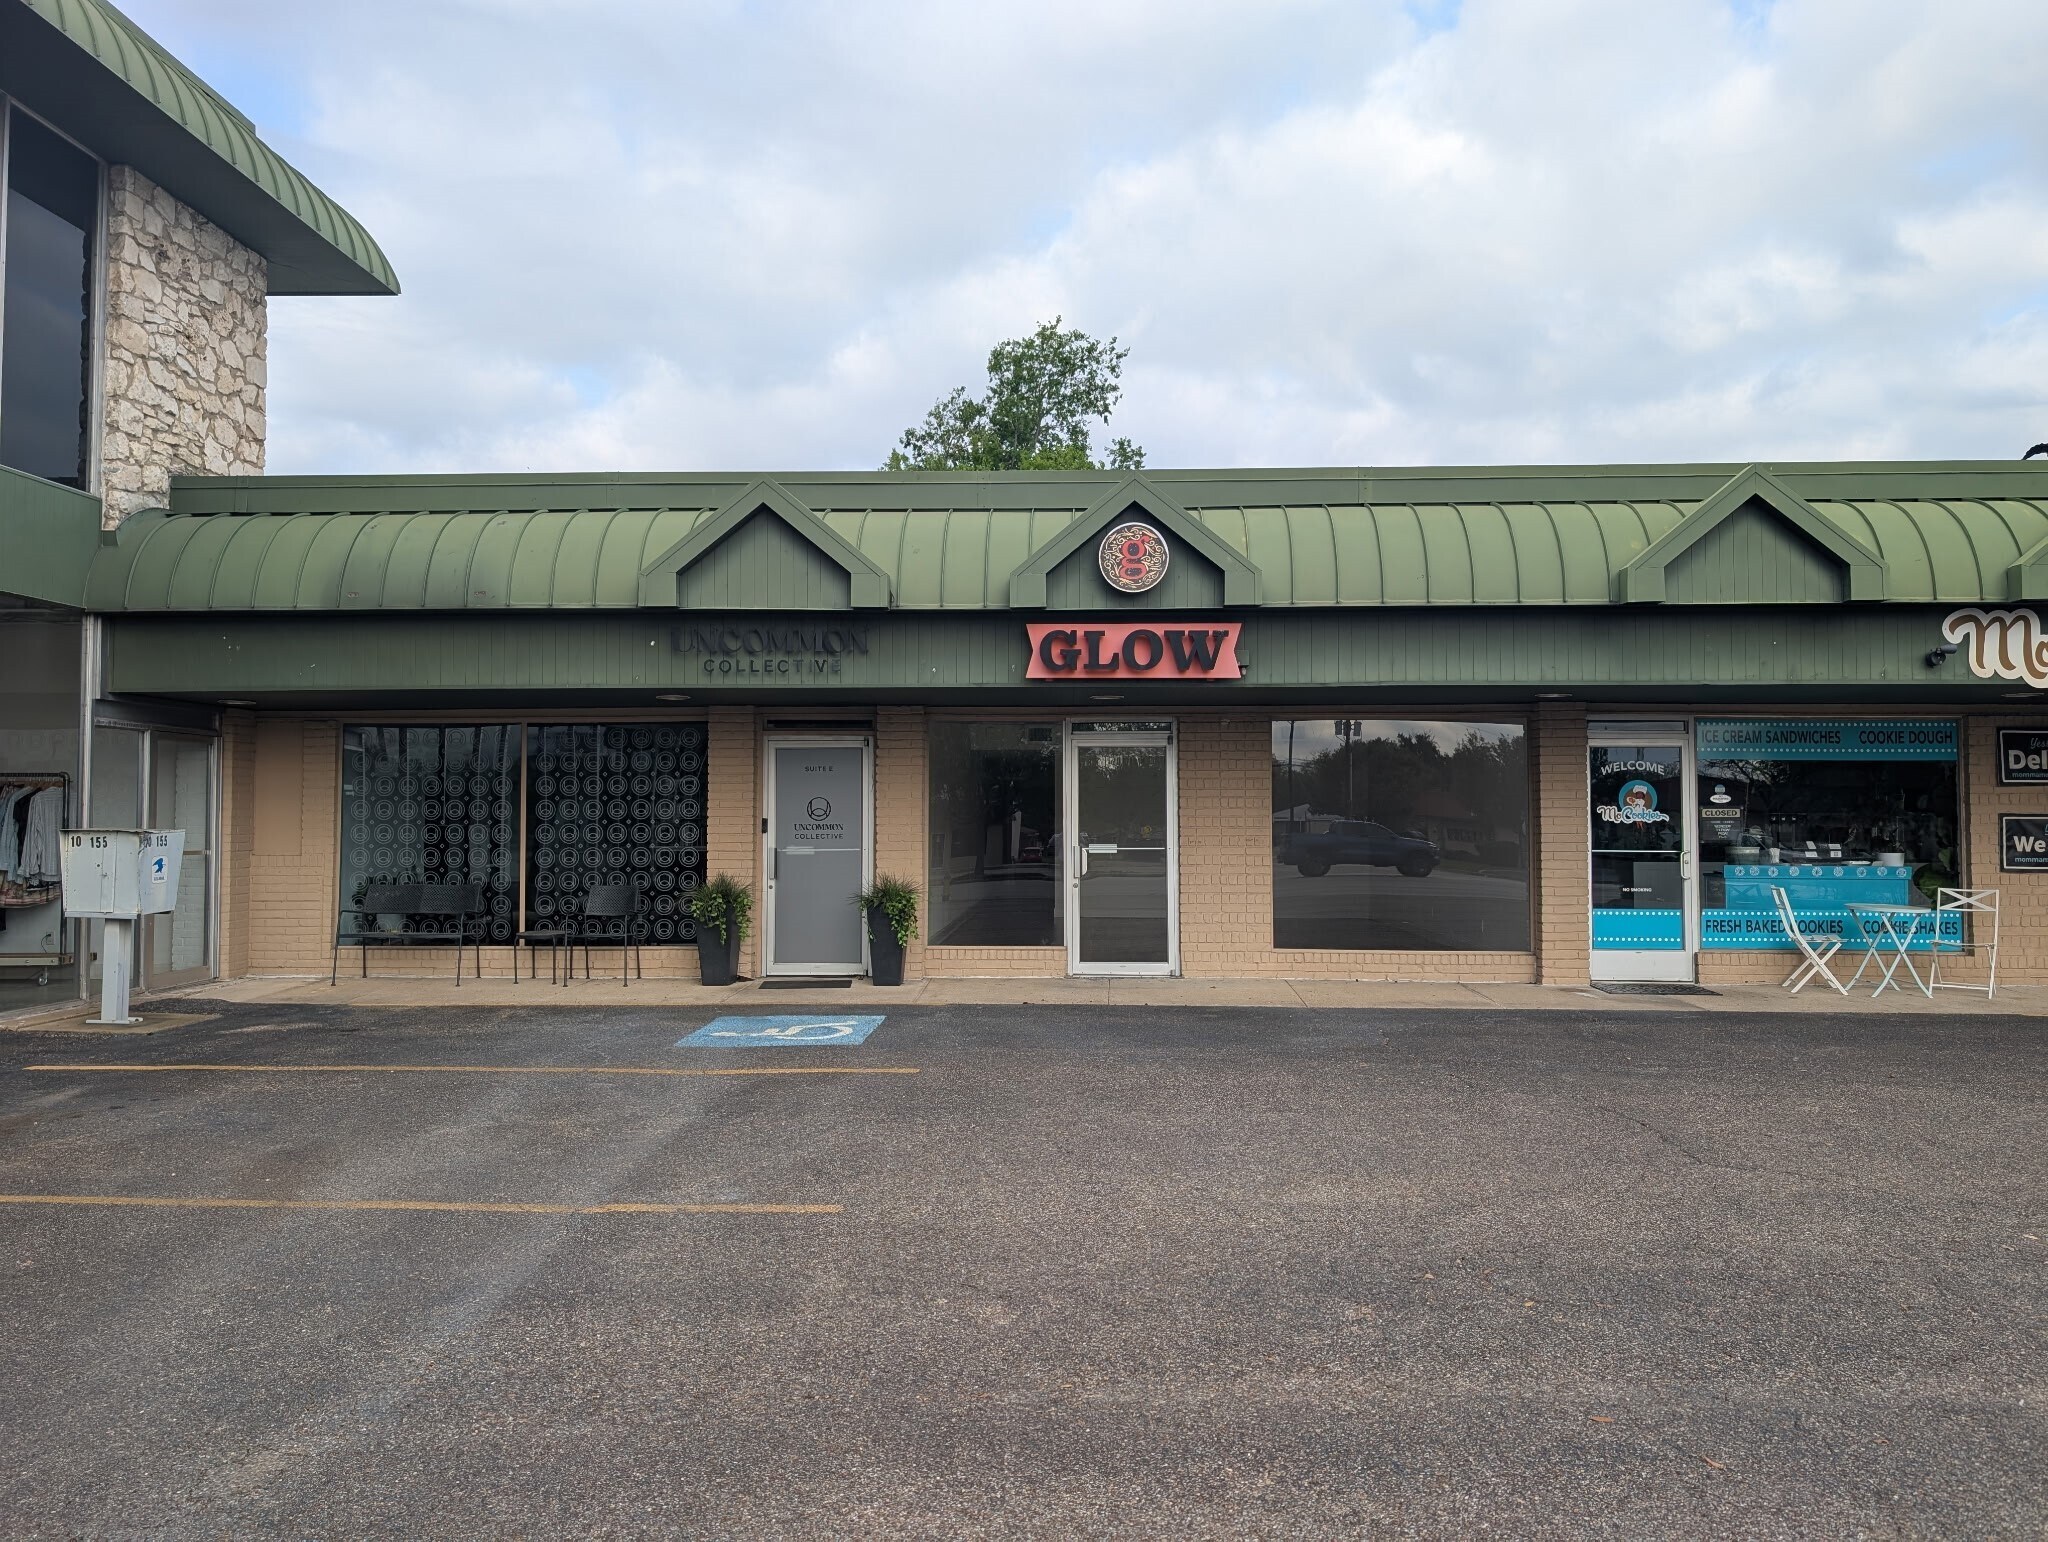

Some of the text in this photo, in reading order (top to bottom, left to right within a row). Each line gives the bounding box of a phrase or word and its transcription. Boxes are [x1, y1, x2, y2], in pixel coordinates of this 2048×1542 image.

[672, 628, 870, 655] UNCOMMON
[1040, 629, 1229, 672] GLOW
[703, 659, 842, 673] COLLECTIVE
[1701, 730, 1841, 744] ICE CREAM SANDWICHES
[1858, 730, 1953, 744] COOKIE DOUGH
[2030, 737, 2048, 750] Yes
[1600, 760, 1665, 776] WELCOME
[1704, 809, 1738, 817] CLOSED
[793, 823, 844, 831] UNCOMMON
[71, 835, 108, 848] 10 155
[156, 835, 168, 848] 155
[2013, 835, 2046, 853] We
[1705, 919, 1742, 934] FRESH
[1746, 919, 1784, 934] BAKED
